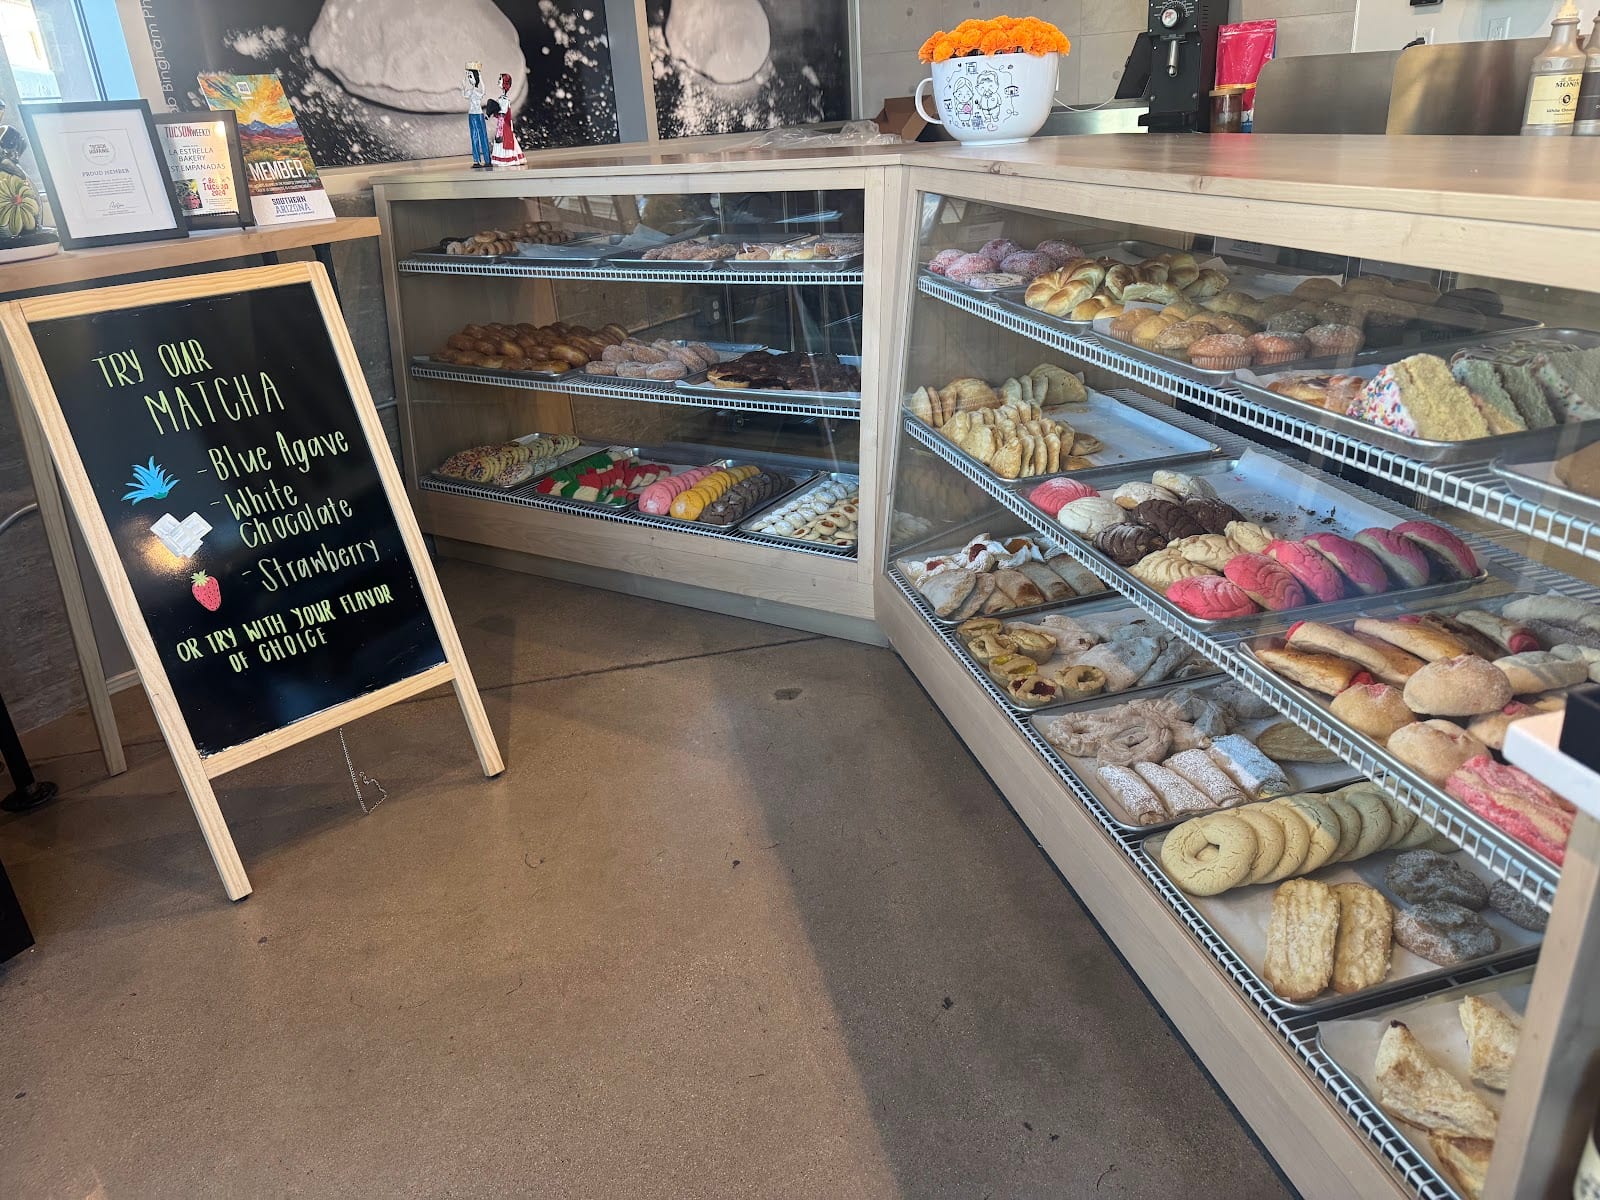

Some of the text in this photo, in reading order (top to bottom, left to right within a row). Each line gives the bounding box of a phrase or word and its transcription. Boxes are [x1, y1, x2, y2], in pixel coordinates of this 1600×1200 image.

[149, 24, 174, 92] Bingham
[168, 163, 226, 173] ST EMPANADAS
[169, 147, 214, 156] LA ESTRELLA
[178, 154, 206, 162] BAKERY
[248, 159, 307, 181] MEMBER
[271, 195, 307, 206] SOUTHERN
[275, 202, 312, 214] ARIZONA
[91, 339, 214, 388] TRY OUR
[143, 371, 285, 435] MATCHA
[275, 430, 349, 474] Agave
[239, 497, 353, 549] Chocolate
[176, 583, 394, 663] OR TRY WITH YOUR FLAVOR
[228, 627, 328, 673] OF CHOICE
